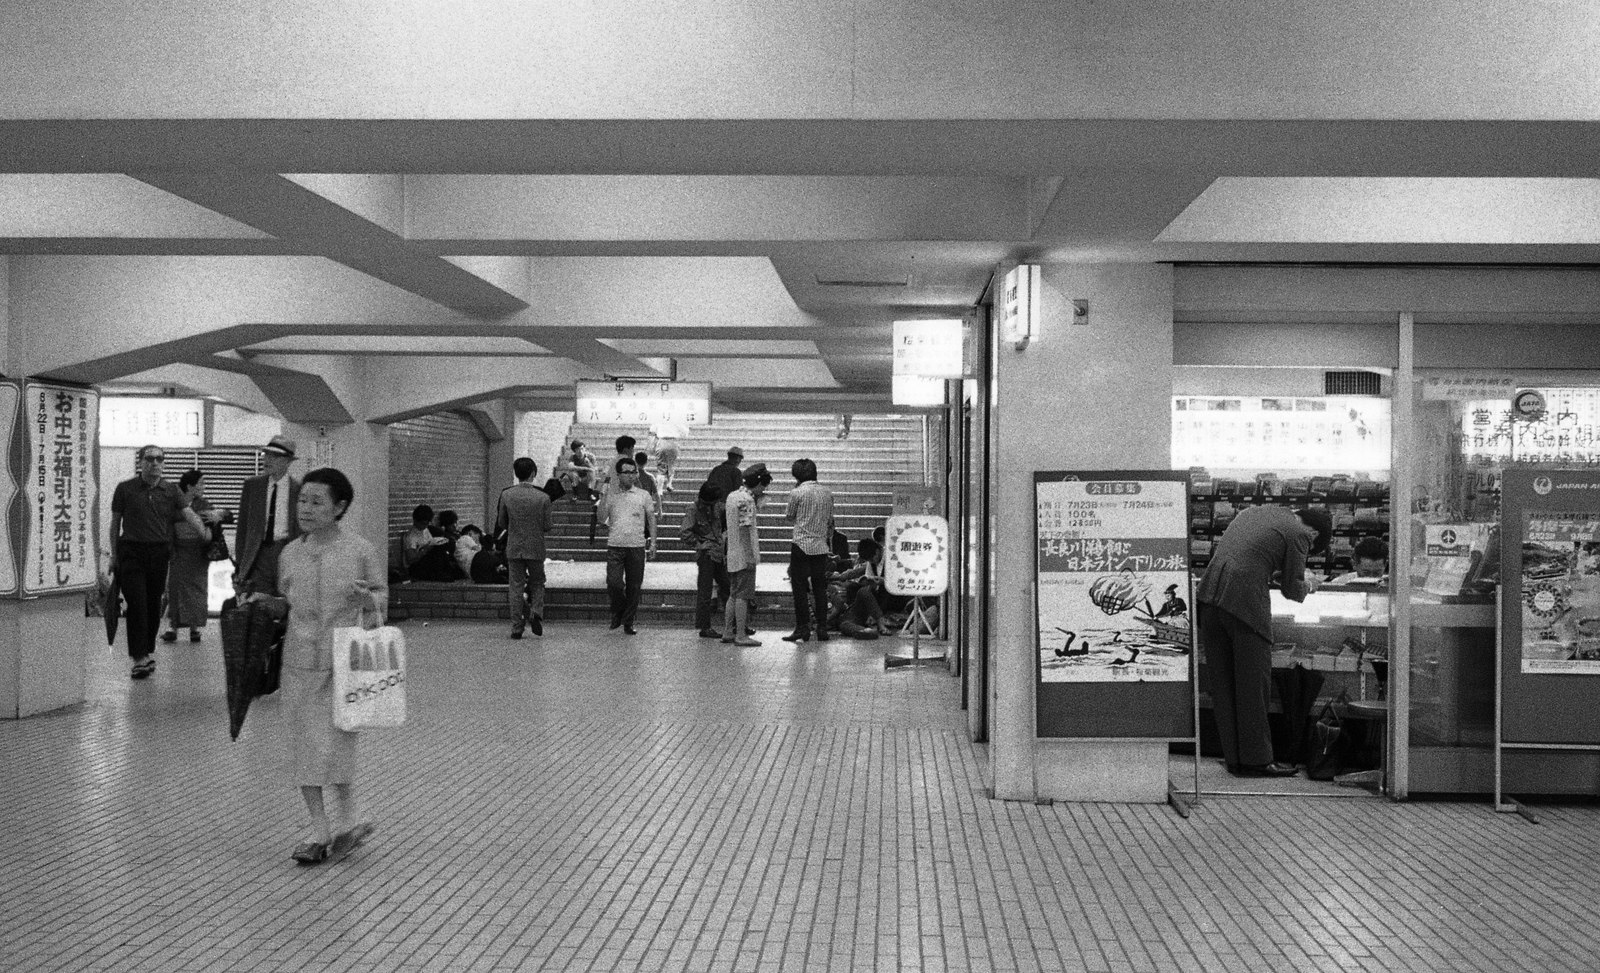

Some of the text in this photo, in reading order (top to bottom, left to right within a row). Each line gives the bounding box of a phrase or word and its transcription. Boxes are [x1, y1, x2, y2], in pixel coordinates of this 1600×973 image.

[53, 391, 73, 586] お中元福引大売出し
[1041, 539, 1132, 557] 長良川鵜飼と
[1067, 554, 1187, 571] 日本ライン下りの旅
